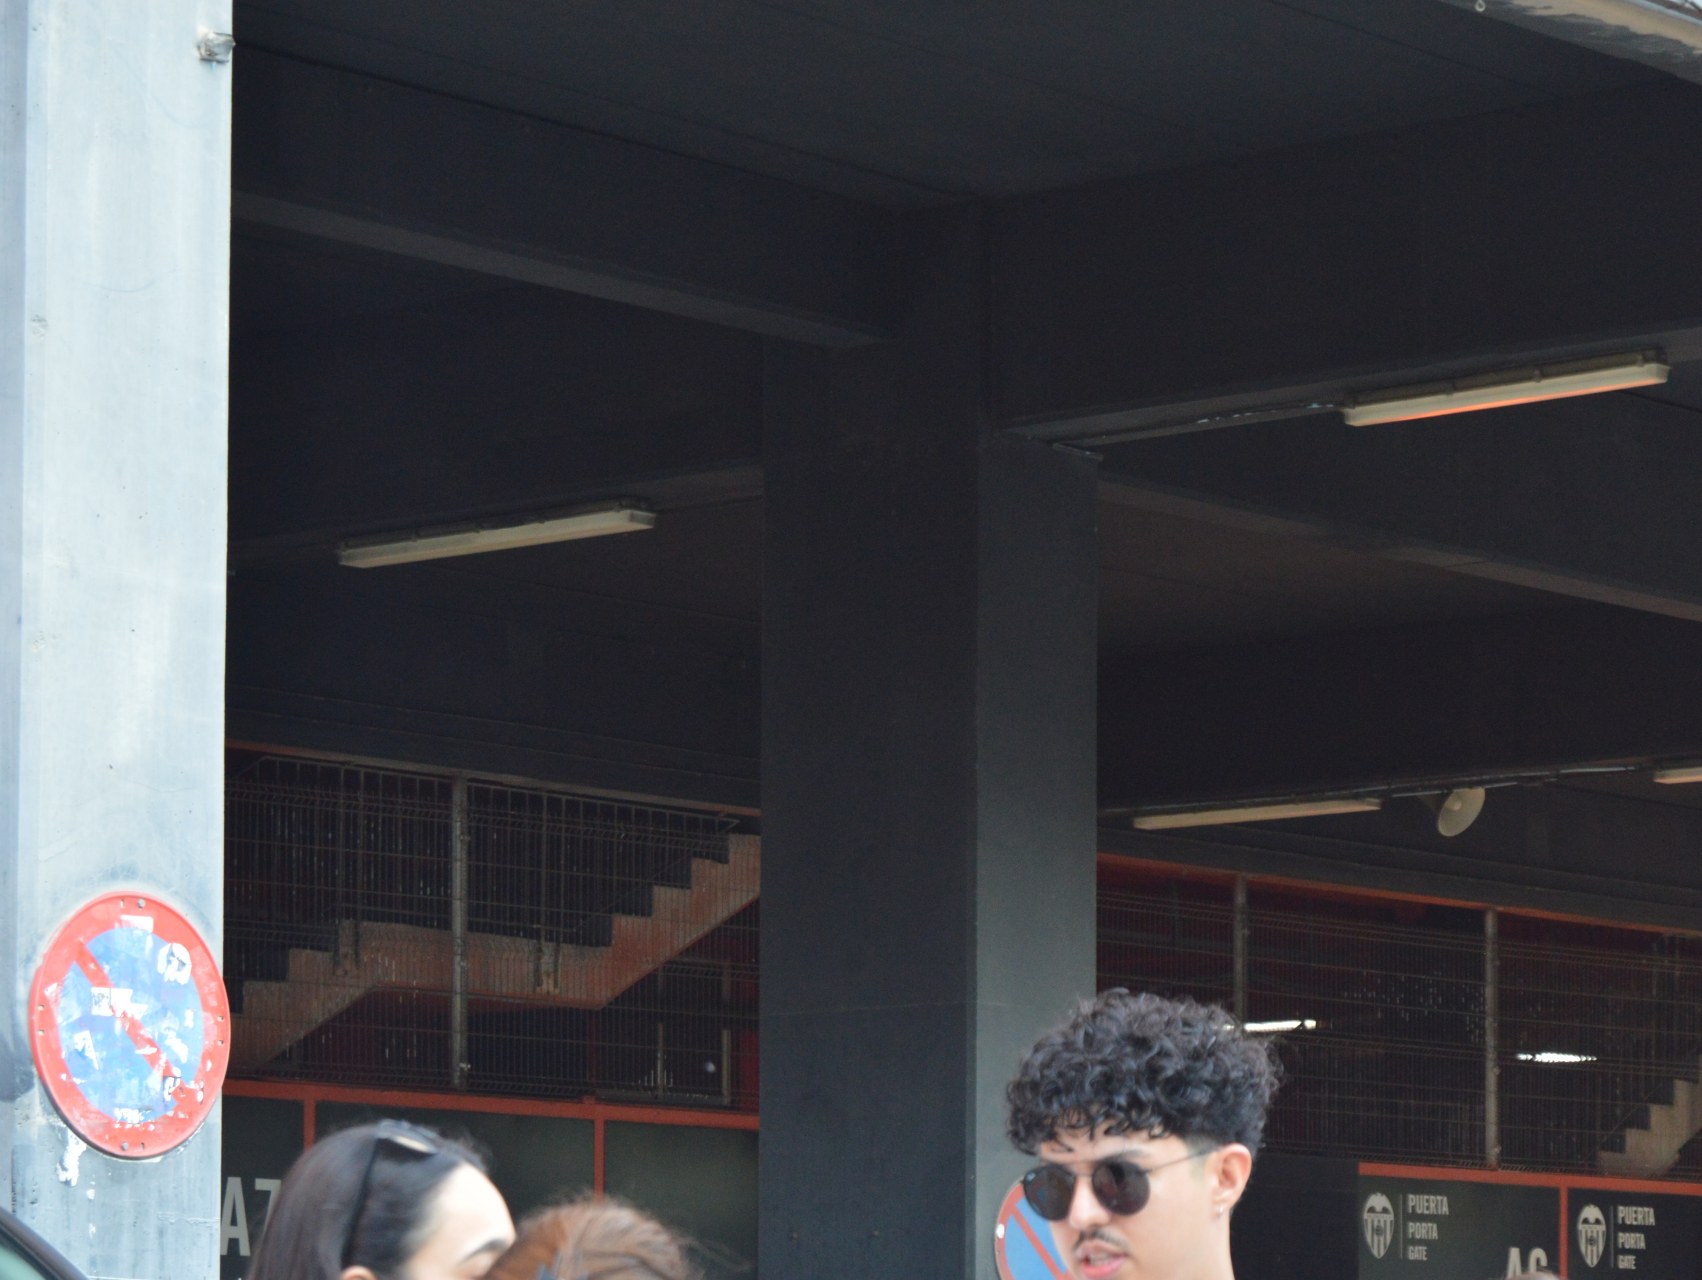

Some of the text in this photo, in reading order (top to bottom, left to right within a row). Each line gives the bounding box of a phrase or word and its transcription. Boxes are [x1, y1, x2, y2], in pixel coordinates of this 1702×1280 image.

[1408, 1194, 1449, 1215] PUERTA
[1617, 1206, 1656, 1226] PUERTA
[1408, 1222, 1438, 1240] PORTA
[1617, 1232, 1646, 1249] PORTA
[1408, 1246, 1427, 1260] GATE
[1617, 1255, 1636, 1269] GATE
